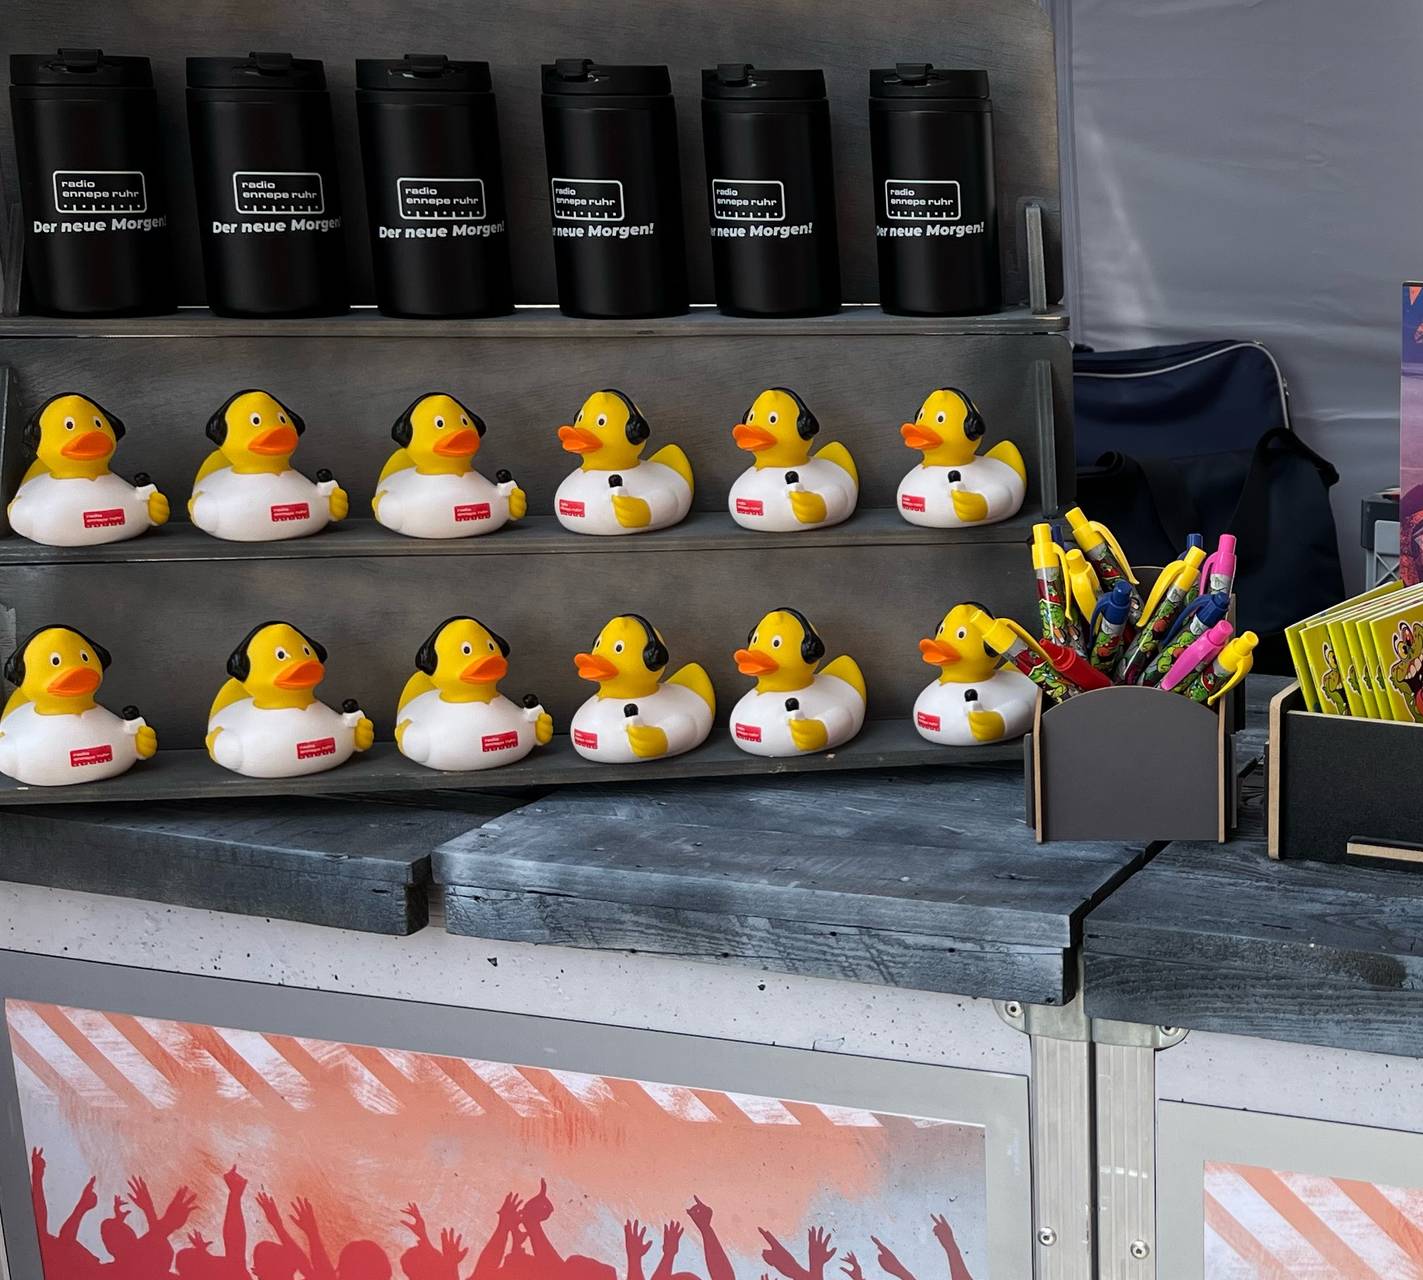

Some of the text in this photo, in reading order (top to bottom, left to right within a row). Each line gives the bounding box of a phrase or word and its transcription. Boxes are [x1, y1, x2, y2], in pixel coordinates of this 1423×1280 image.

[61, 180, 95, 188] radio
[241, 181, 276, 189] radio
[62, 189, 139, 199] ennepe ruhr
[242, 190, 317, 200] ennepe ruhr
[405, 187, 438, 195] radio
[716, 188, 738, 196] radio
[890, 188, 915, 196] radio
[406, 196, 479, 206] ennepe ruhr
[588, 198, 616, 206] ruhr
[717, 198, 777, 207] ennepe ruhr
[890, 197, 953, 207] ennepe ruhr
[33, 220, 57, 233] Der
[61, 221, 107, 233] neue
[212, 216, 341, 234] Der neue Morgen
[379, 220, 505, 239] Der neue Morgen!
[889, 226, 922, 237] neue
[926, 221, 985, 238] Morgen!
[557, 226, 585, 237] neue
[588, 222, 654, 239] Morgen!
[717, 226, 746, 237] neue
[749, 222, 813, 239] Morgen!
